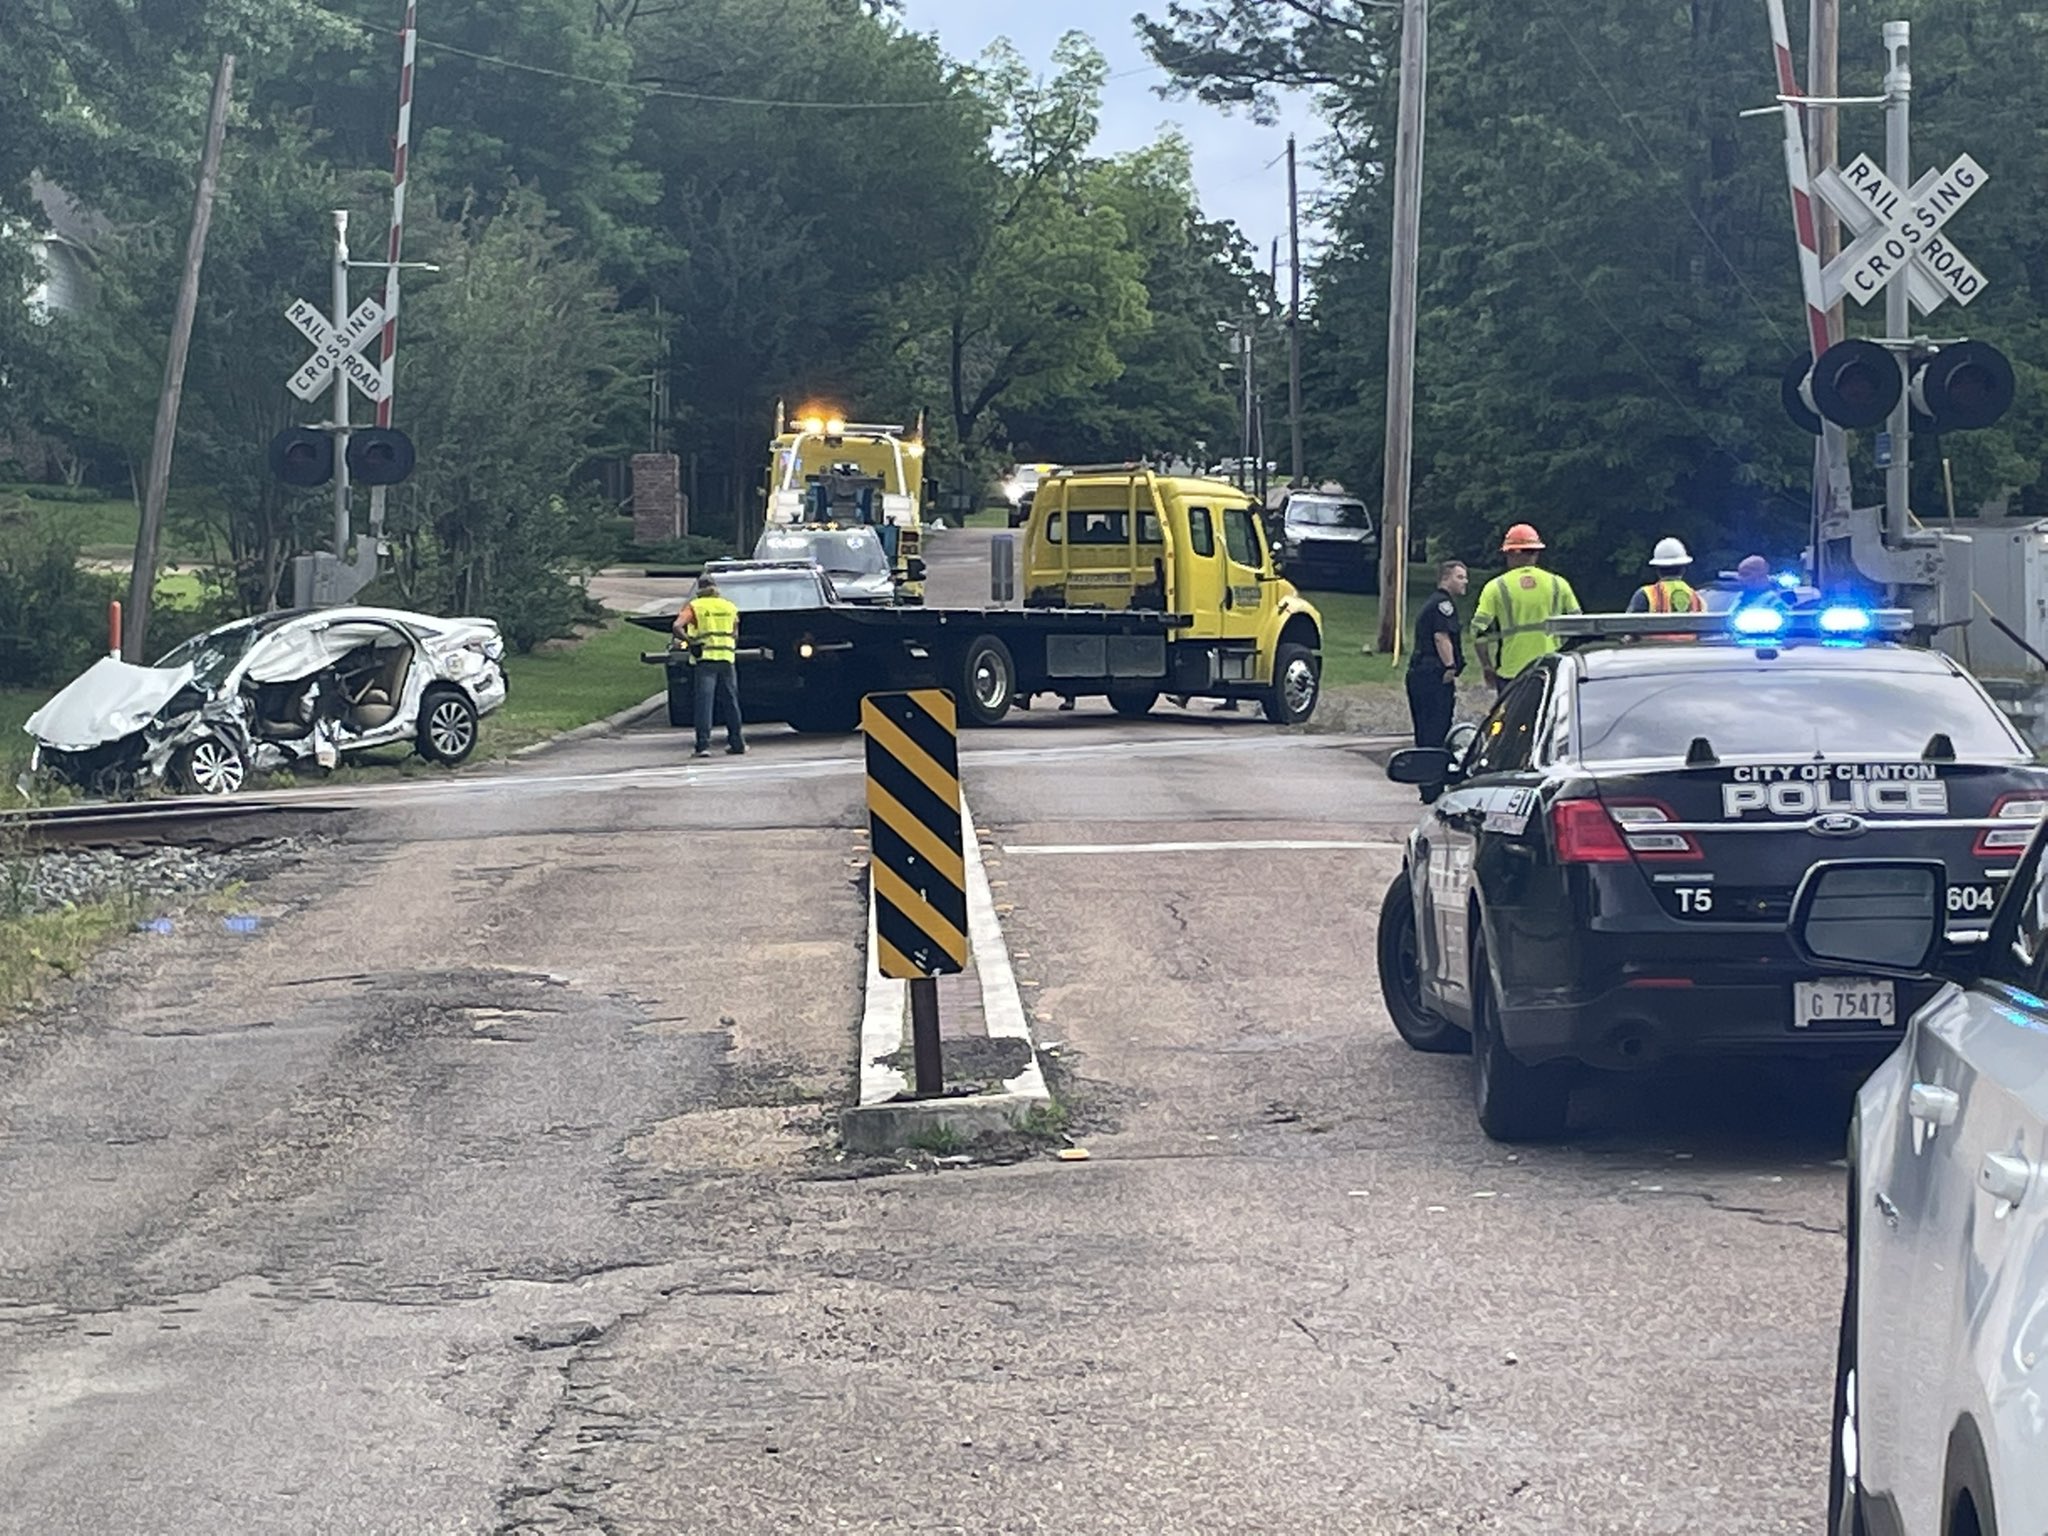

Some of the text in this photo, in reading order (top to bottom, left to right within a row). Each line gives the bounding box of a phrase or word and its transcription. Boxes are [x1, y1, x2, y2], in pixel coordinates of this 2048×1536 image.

[1847, 162, 1979, 298] RAIL ROAD
[1854, 167, 1975, 291] CROSSING
[290, 304, 380, 394] RAIL ROAD
[295, 306, 376, 391] CROSSING
[1733, 764, 1937, 782] CITY OF CLINTON
[1721, 780, 1949, 818] POLICE
[1674, 888, 1713, 912] T5
[1946, 886, 1995, 911] 604
[1812, 992, 1894, 1017] G 75473
